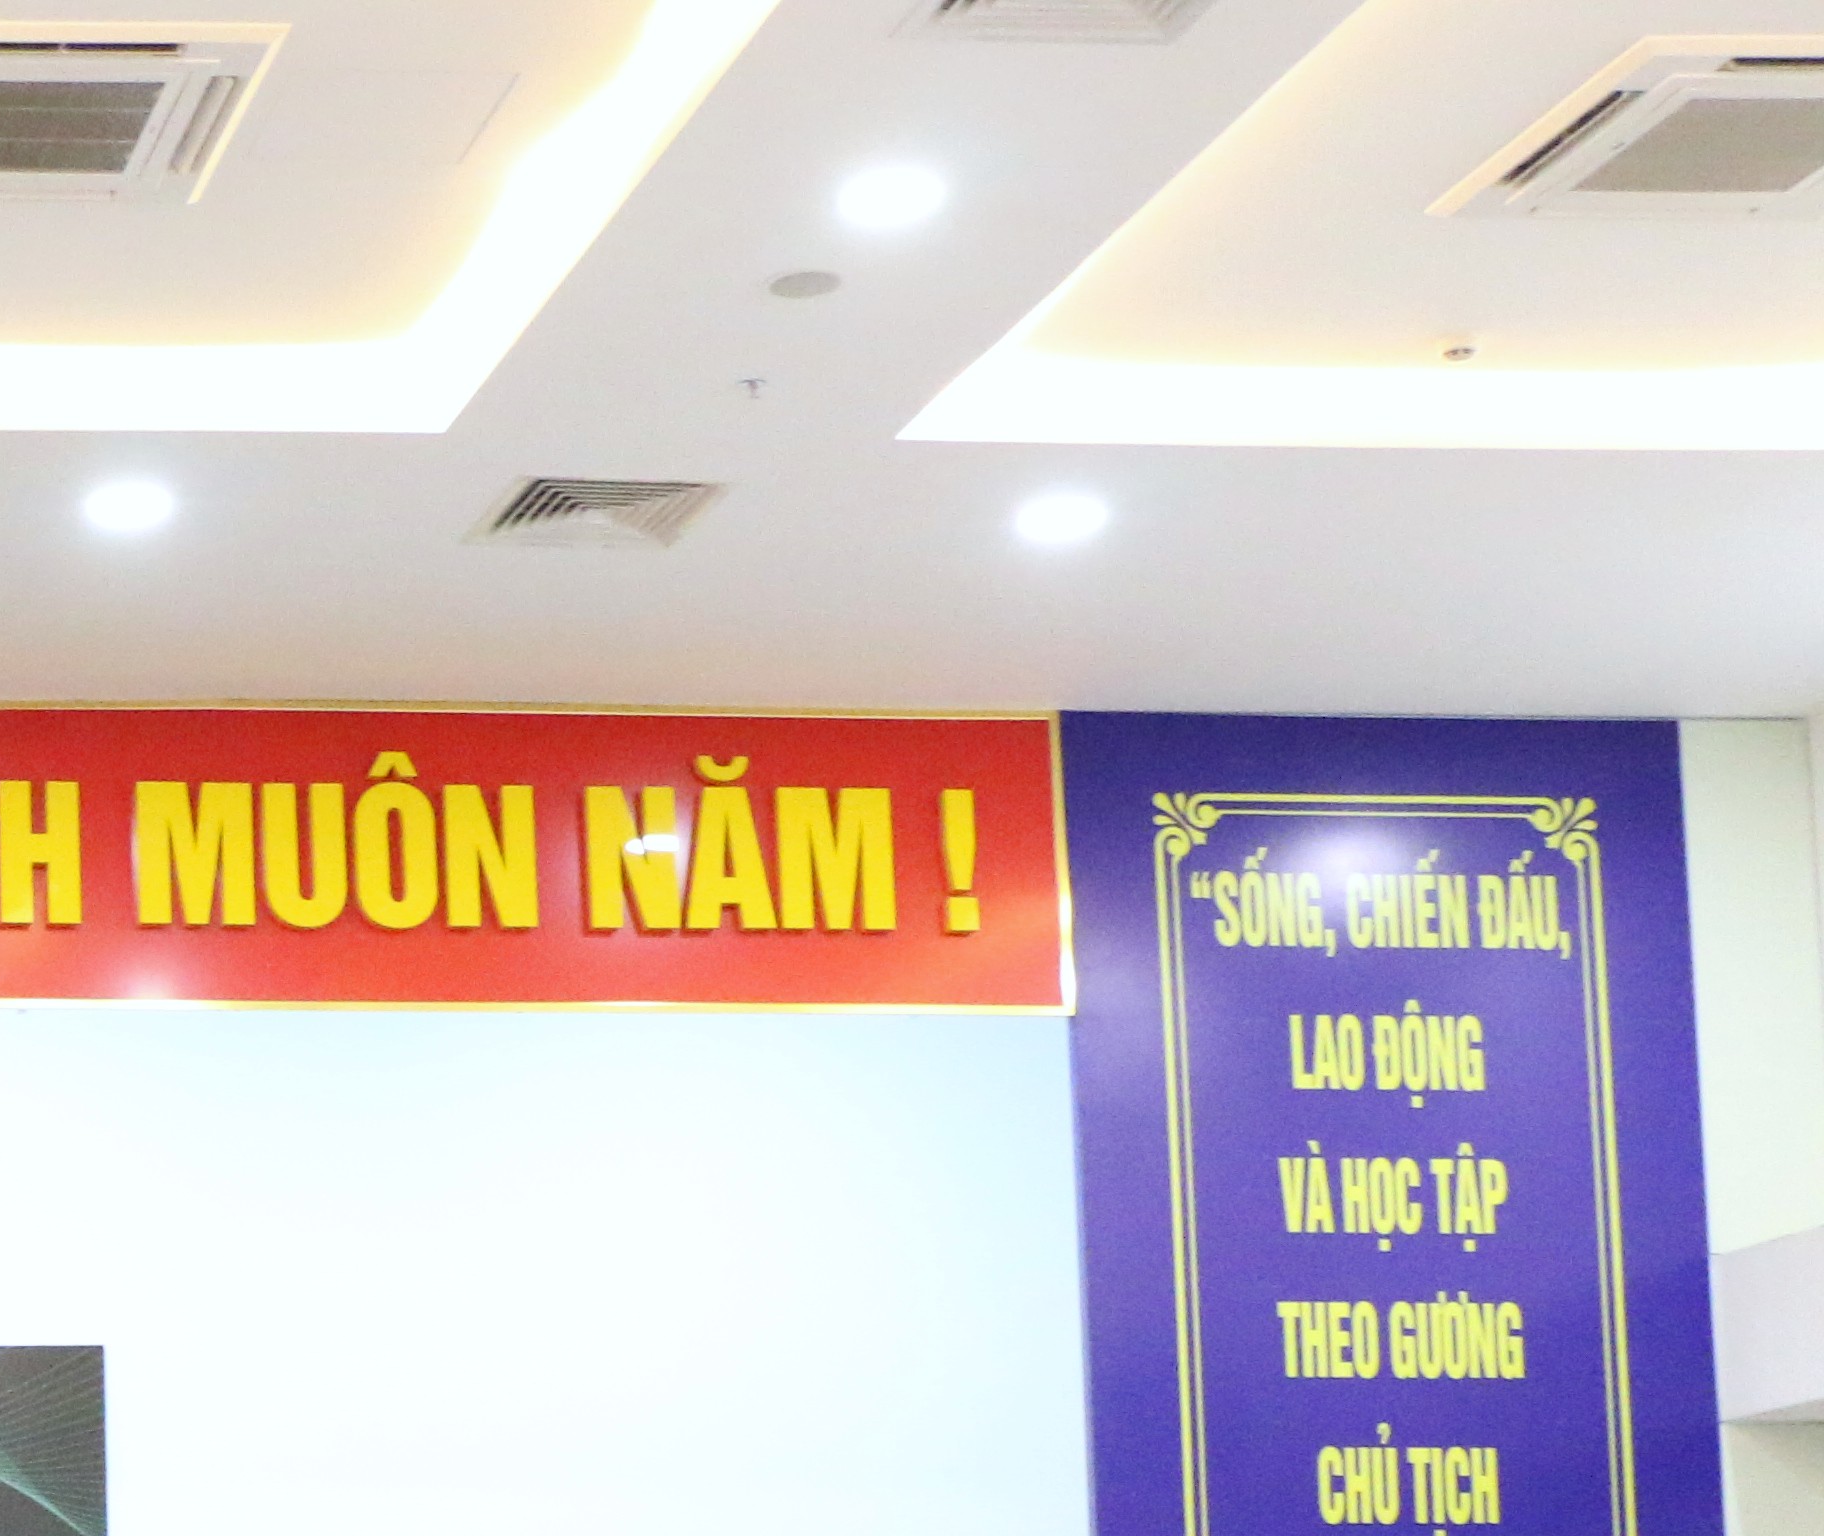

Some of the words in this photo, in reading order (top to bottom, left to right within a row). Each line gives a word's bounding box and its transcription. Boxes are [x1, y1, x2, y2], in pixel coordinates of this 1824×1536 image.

[133, 750, 540, 930] MUÔN
[586, 756, 899, 932] NĂM
[943, 790, 981, 935] !
[1190, 849, 1336, 957] “SỐNG,
[1348, 850, 1470, 948] CHIẾN
[1479, 850, 1572, 958] ĐẤU,
[1291, 1014, 1365, 1090] LAO
[1373, 1000, 1485, 1107] ĐỘNG
[1280, 1142, 1335, 1232] VÀ
[1342, 1158, 1423, 1250] HỌC
[1432, 1143, 1508, 1251] TẬP
[1278, 1301, 1380, 1378] THEO
[1390, 1293, 1525, 1378] GƯƠNG
[1319, 1424, 1400, 1524] CHỦ
